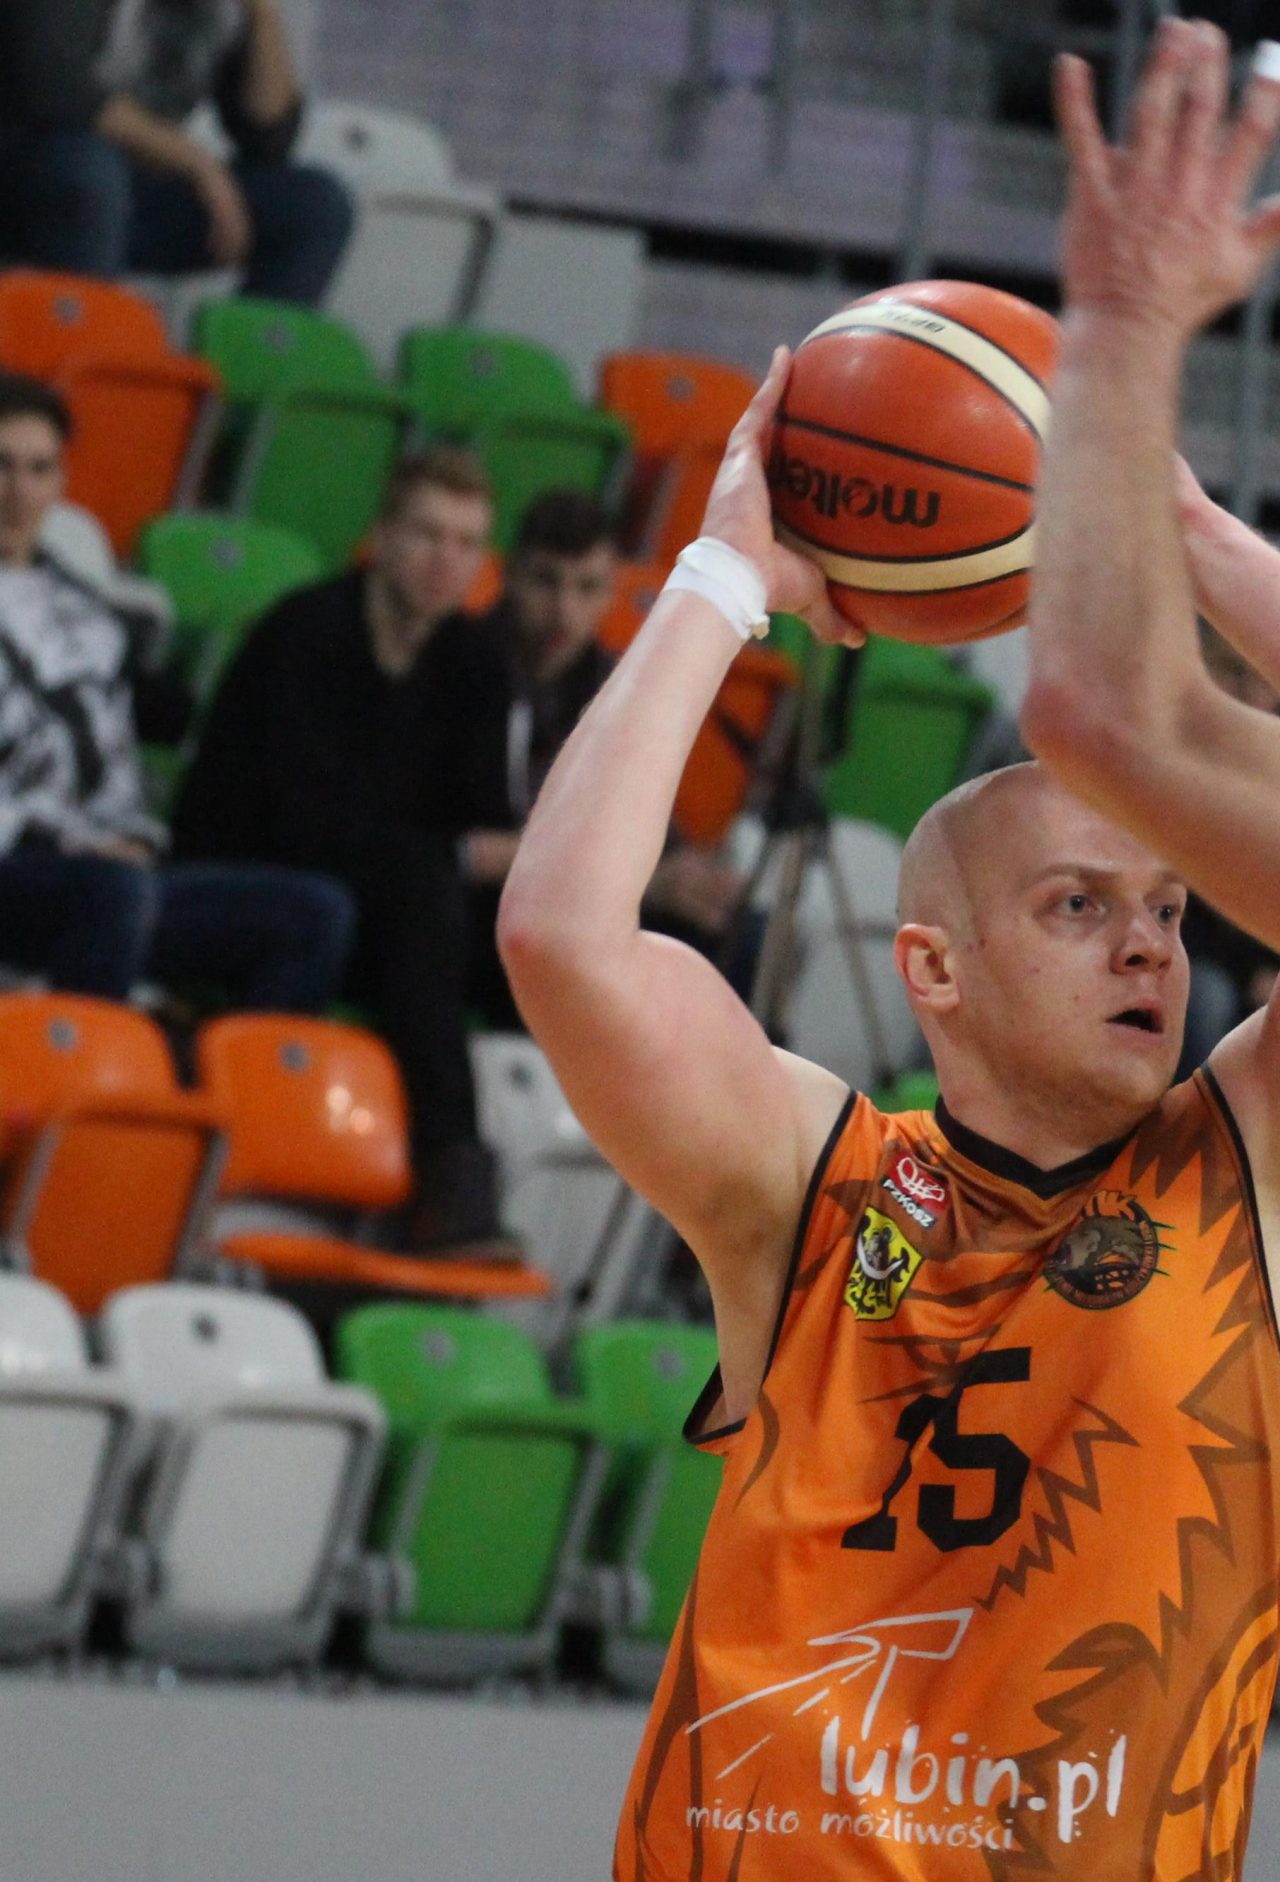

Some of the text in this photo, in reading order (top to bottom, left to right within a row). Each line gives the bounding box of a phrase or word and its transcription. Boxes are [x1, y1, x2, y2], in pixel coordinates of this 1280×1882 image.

[882, 1178, 934, 1227] PZKOSZ
[841, 1346, 1032, 1552] 15
[686, 1798, 1014, 1850] miasto możliwości
[820, 1715, 1127, 1843] lubin.pl
